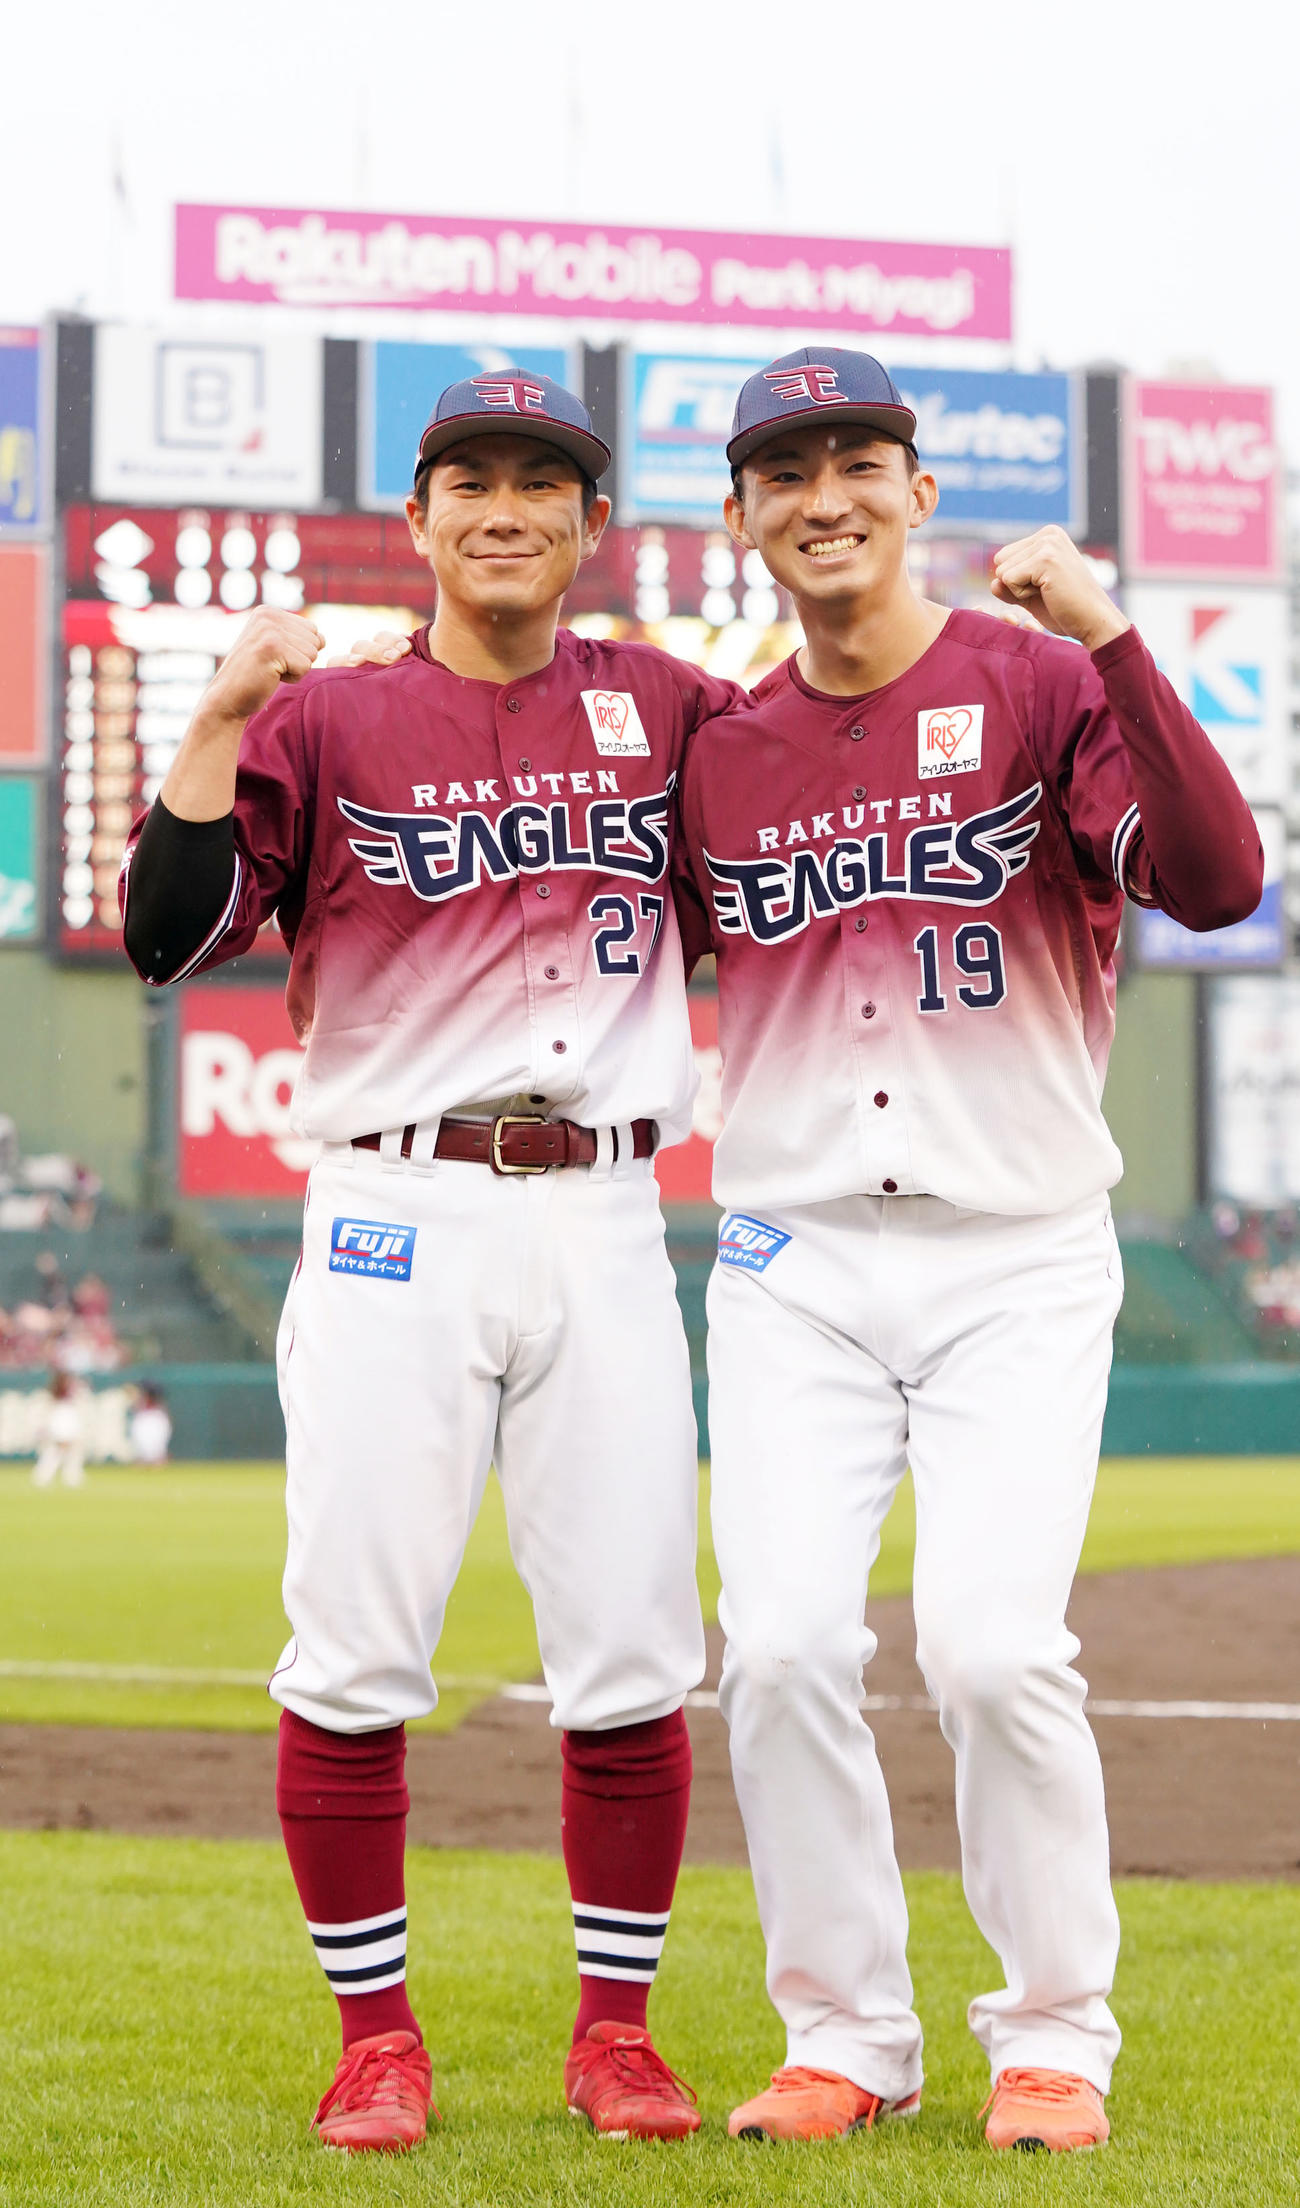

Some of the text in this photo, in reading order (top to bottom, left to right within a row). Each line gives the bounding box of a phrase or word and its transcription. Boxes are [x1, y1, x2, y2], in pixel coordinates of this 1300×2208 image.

[214, 212, 975, 330] Rakuten Mobile Park Miyagi
[594, 705, 622, 729] IRIS
[598, 742, 648, 753] アイリスオーヤマ
[926, 723, 957, 751] IRIS
[919, 757, 979, 777] アイリスオーヤマ
[411, 770, 621, 808] RAKUTEN
[337, 779, 672, 902] EAGLES
[756, 791, 954, 853] RAKUTEN
[702, 781, 1043, 946] EAGLES
[587, 892, 665, 978] 27
[913, 921, 1008, 1015] 19
[337, 1222, 410, 1259] Fuji
[721, 1218, 785, 1251] Fuji
